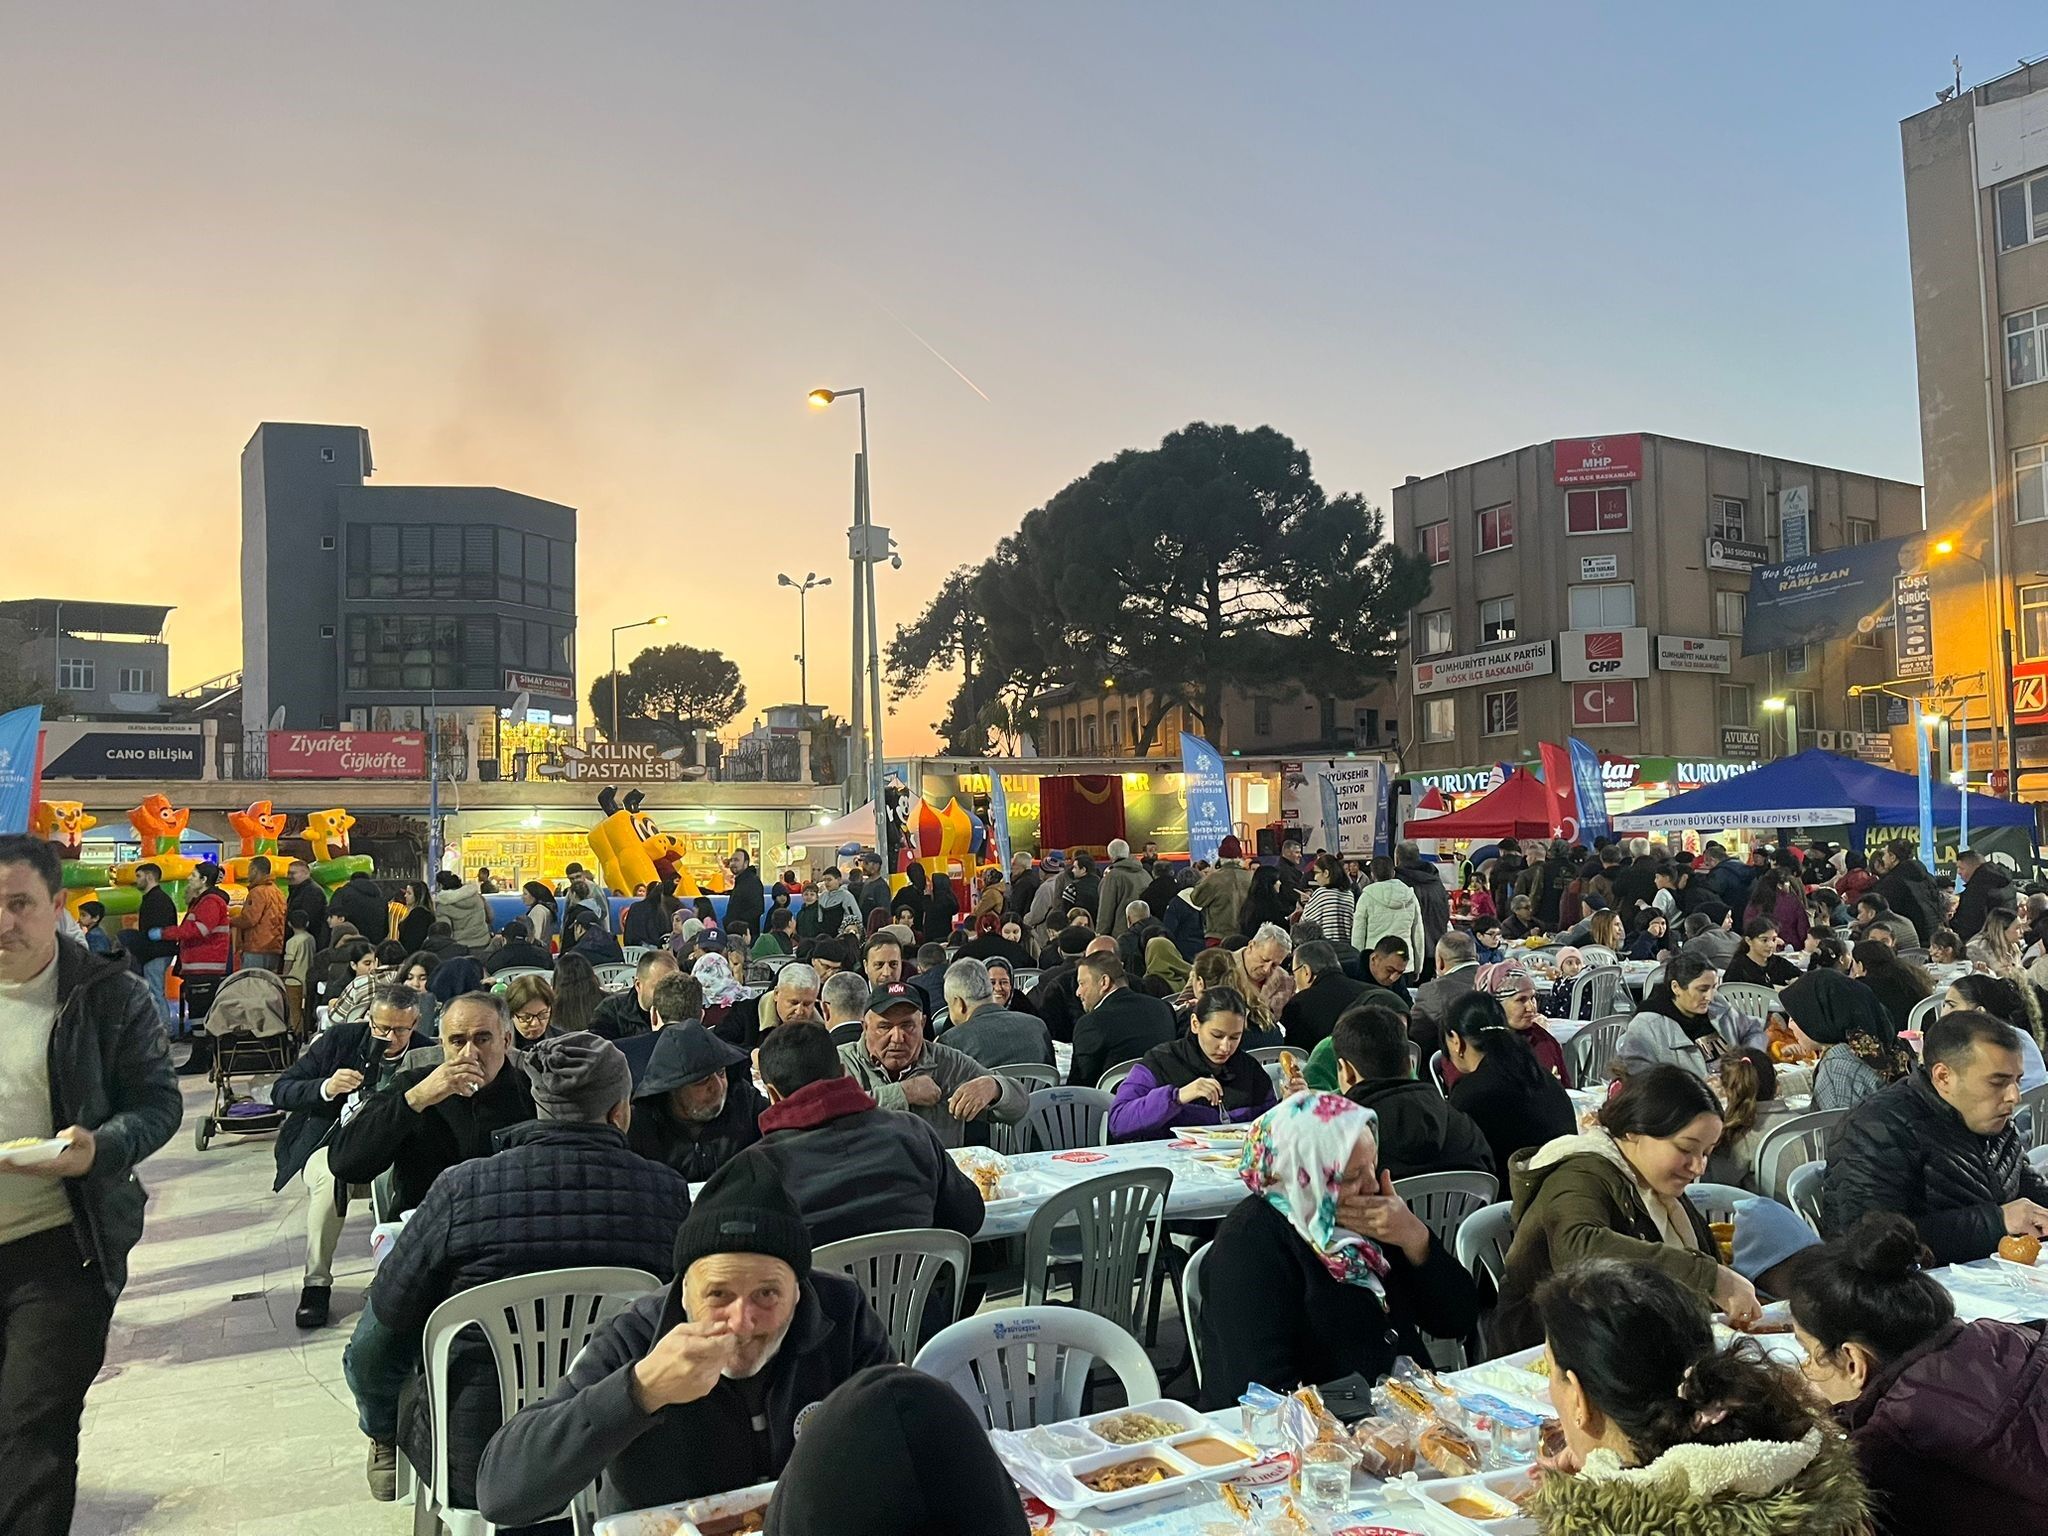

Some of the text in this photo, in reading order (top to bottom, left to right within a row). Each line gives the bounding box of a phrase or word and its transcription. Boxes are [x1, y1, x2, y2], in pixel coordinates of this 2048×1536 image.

[1583, 457, 1612, 468] MHP
[1762, 561, 1818, 580] Hoş Geldin
[1779, 567, 1850, 592] RAMAZAN
[1899, 575, 1928, 590] KÖŞK
[1435, 644, 1546, 675] CUMHURİYET HALK PARTİSİ
[1588, 660, 1621, 673] CHP
[1446, 673, 1468, 684] KÖŞK
[1485, 661, 1534, 678] BAŞKANLIĞI
[1419, 681, 1433, 690] CHP
[1724, 731, 1760, 744] AVUKAT
[289, 735, 353, 756] Ziyafet
[106, 747, 194, 762] CANO BİLİŞİM
[591, 744, 655, 763] KILINÇ
[340, 751, 407, 772] Çiğköfte
[577, 763, 669, 779] PASTANESİ
[1325, 767, 1369, 782] ÜYÜKŞEHİR
[1421, 771, 1492, 793] KURUYE
[1991, 776, 2008, 787] DUR
[1335, 784, 1365, 797] LIŞIYOR
[1008, 802, 1041, 820] HOŞ
[1338, 801, 1358, 811] YDIN
[1664, 818, 1686, 827] AYDIN
[1688, 813, 1749, 827] BÜYÜKŞEHİR
[1751, 814, 1801, 825] BELEDİYESİ
